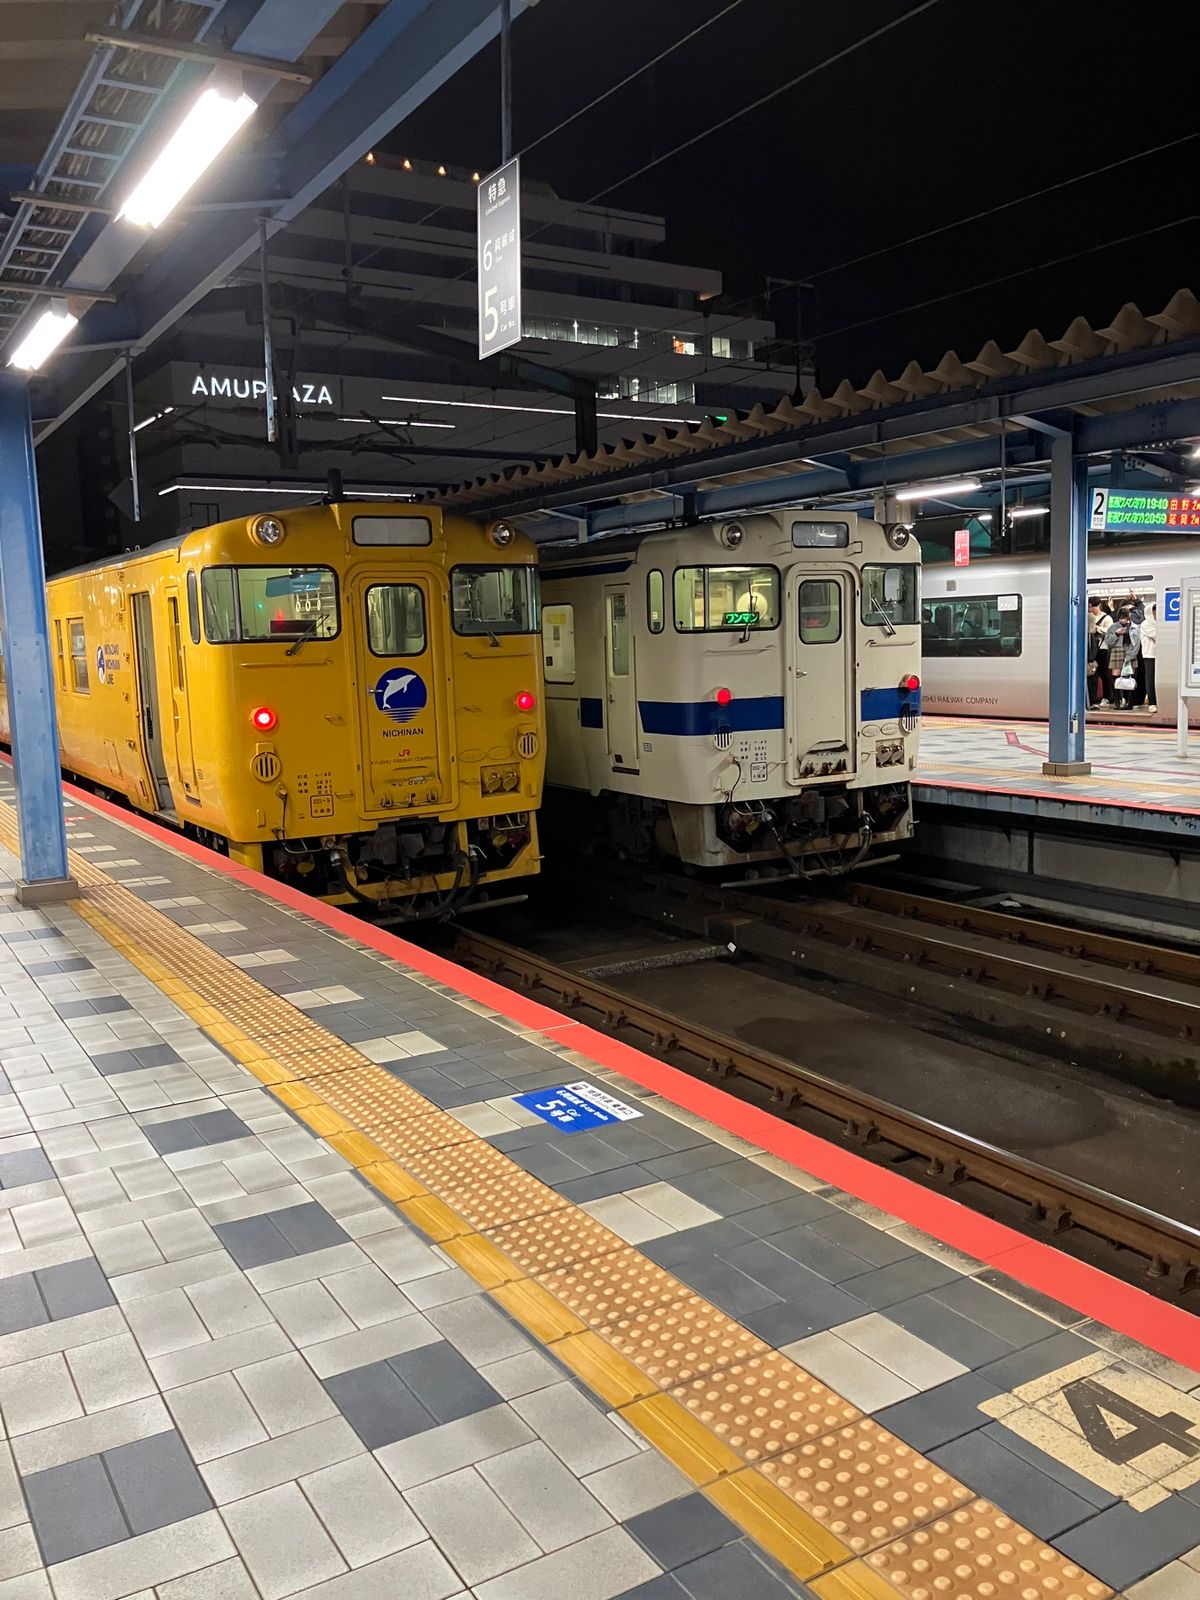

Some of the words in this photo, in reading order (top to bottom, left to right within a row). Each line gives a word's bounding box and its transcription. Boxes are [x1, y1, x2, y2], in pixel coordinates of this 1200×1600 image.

[488, 177, 507, 204] 特急
[483, 239, 493, 272] 6
[484, 286, 499, 342] 5
[500, 295, 516, 316] 号車
[191, 375, 333, 405] AMUPZA
[1093, 492, 1105, 516] 2
[726, 613, 758, 624] ワンマン
[965, 697, 999, 705] COMPANY
[382, 728, 424, 738] NICHINAN
[398, 749, 411, 757] JR
[535, 1099, 567, 1111] 5
[1062, 1378, 1200, 1466] 4
